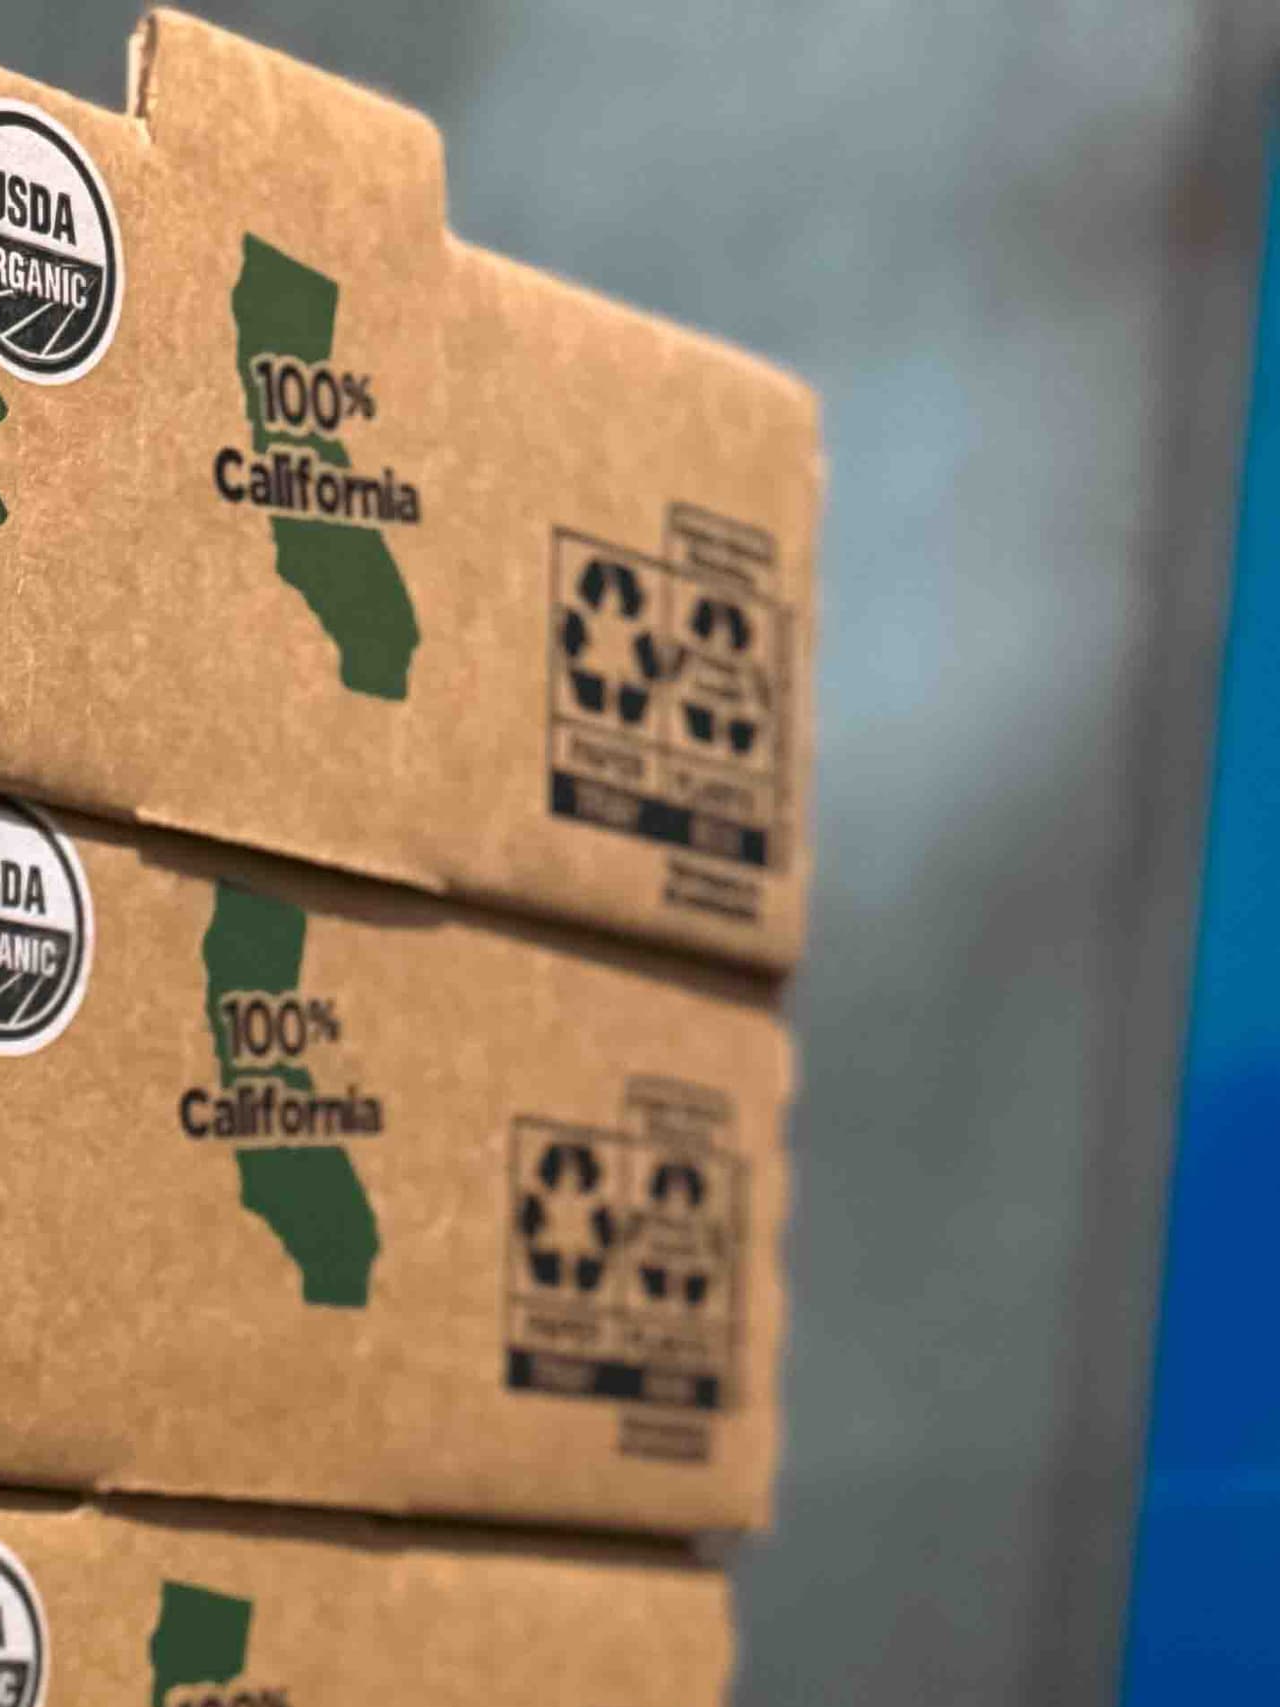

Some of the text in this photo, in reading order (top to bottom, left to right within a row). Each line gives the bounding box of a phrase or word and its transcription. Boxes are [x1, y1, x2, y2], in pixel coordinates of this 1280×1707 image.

[255, 359, 377, 432] 100%
[213, 446, 422, 526] California
[222, 999, 341, 1058] 100%
[178, 1085, 383, 1140] California
